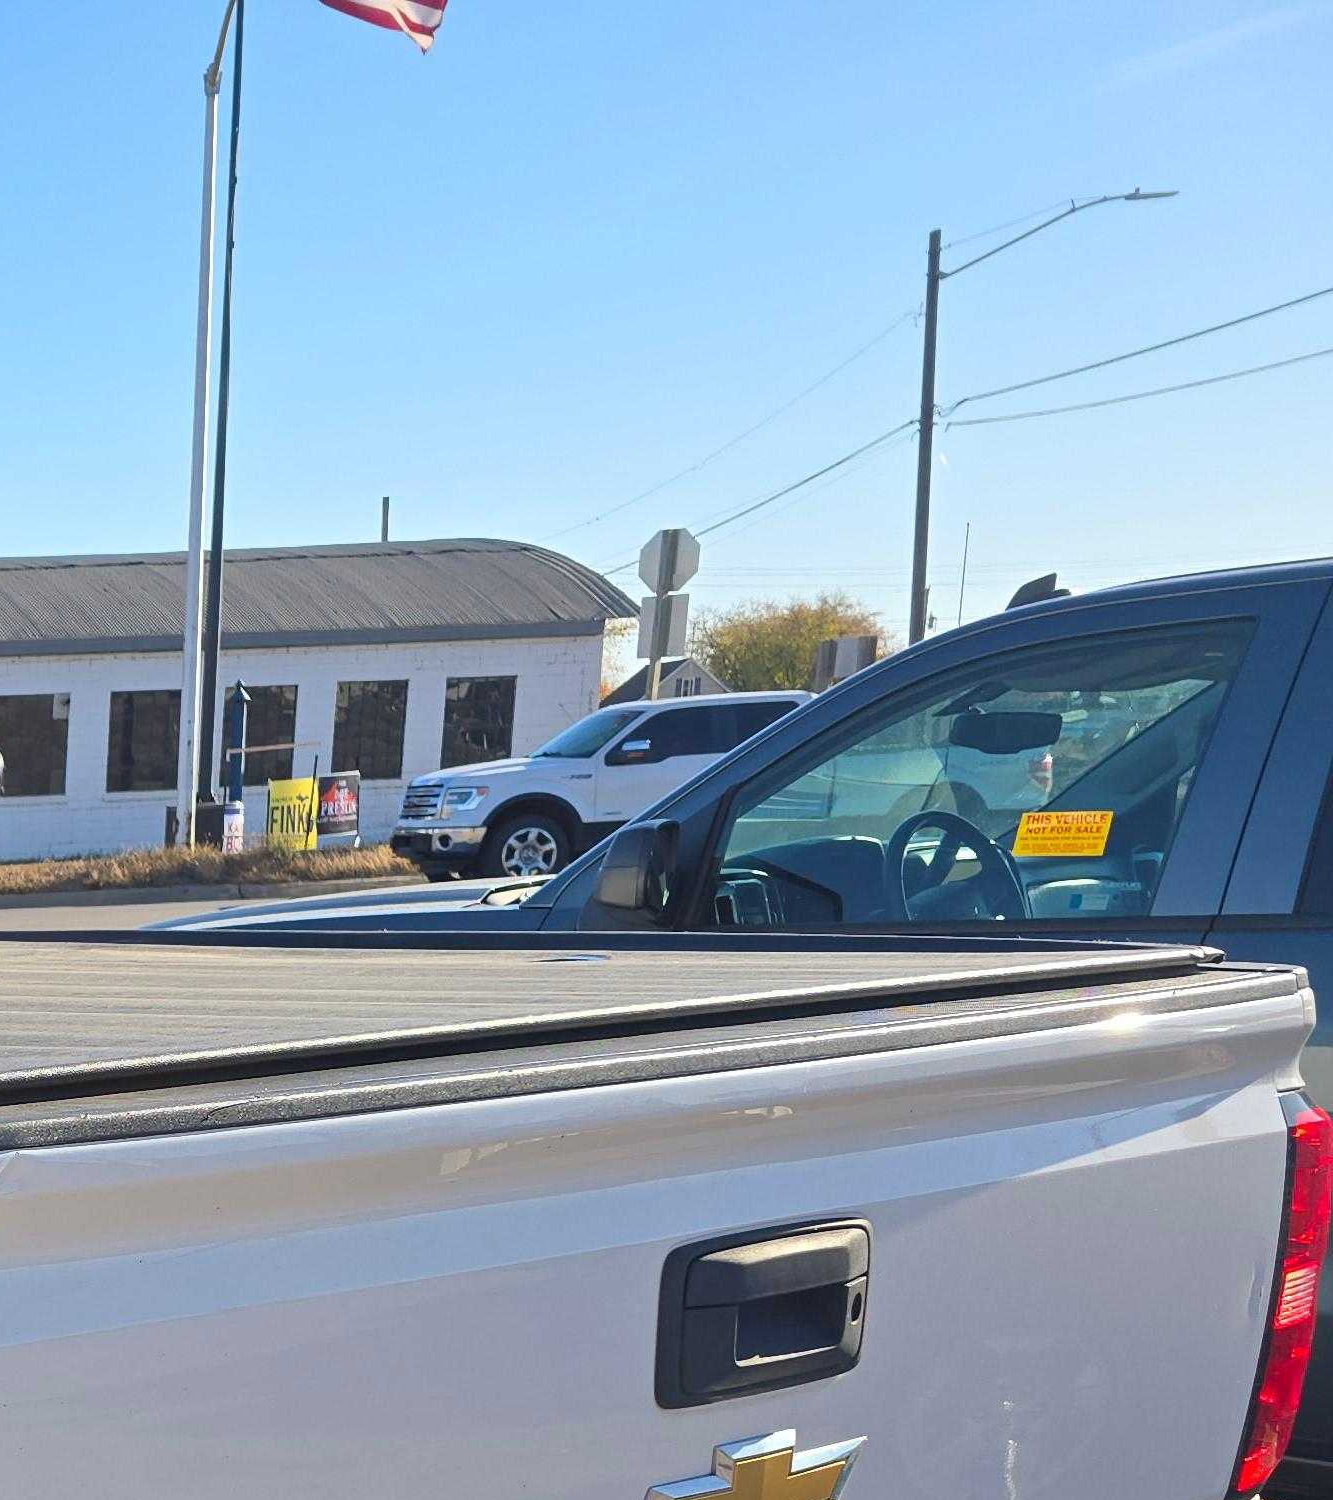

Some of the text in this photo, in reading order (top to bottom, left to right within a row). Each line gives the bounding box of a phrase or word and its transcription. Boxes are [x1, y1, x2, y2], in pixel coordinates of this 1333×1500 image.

[1027, 813, 1109, 825] THIS VEHICLE
[1026, 825, 1103, 834] NOT FOR SALE
